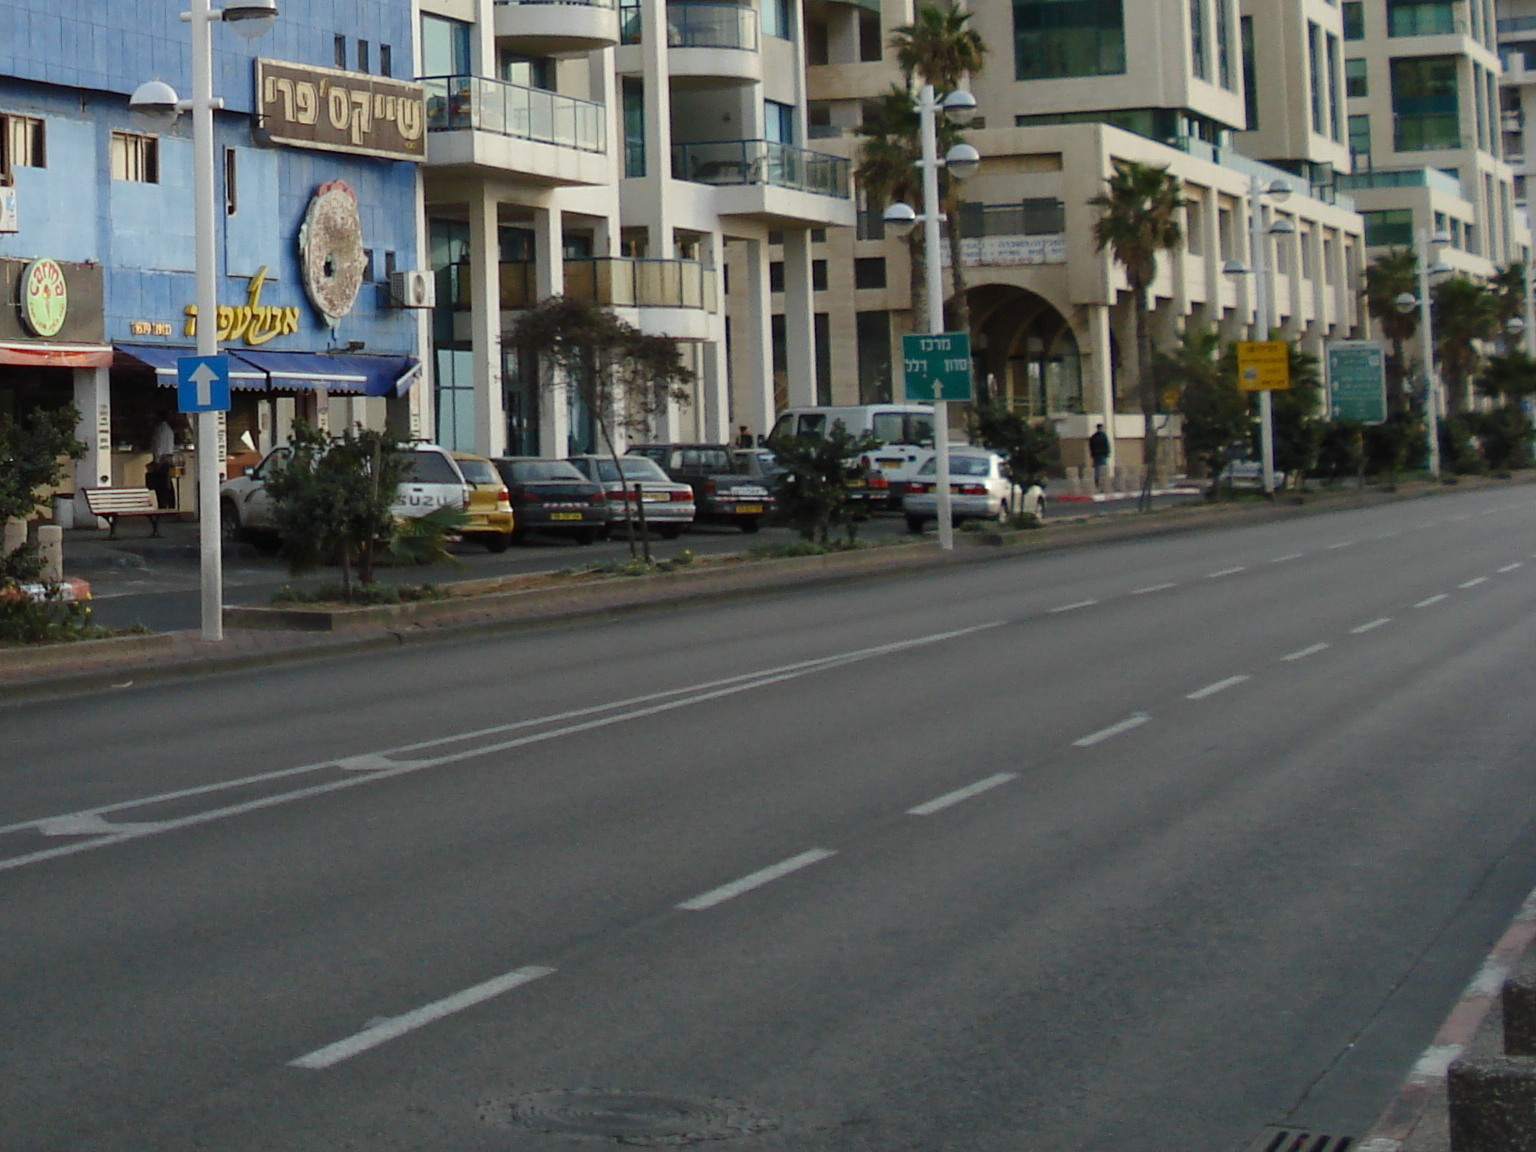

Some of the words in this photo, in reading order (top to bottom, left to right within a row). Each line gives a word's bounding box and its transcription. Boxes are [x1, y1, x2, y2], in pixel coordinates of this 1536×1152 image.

[184, 265, 300, 346] אבולעפה
[920, 338, 951, 351] מרכז
[393, 494, 447, 508] SUZU
